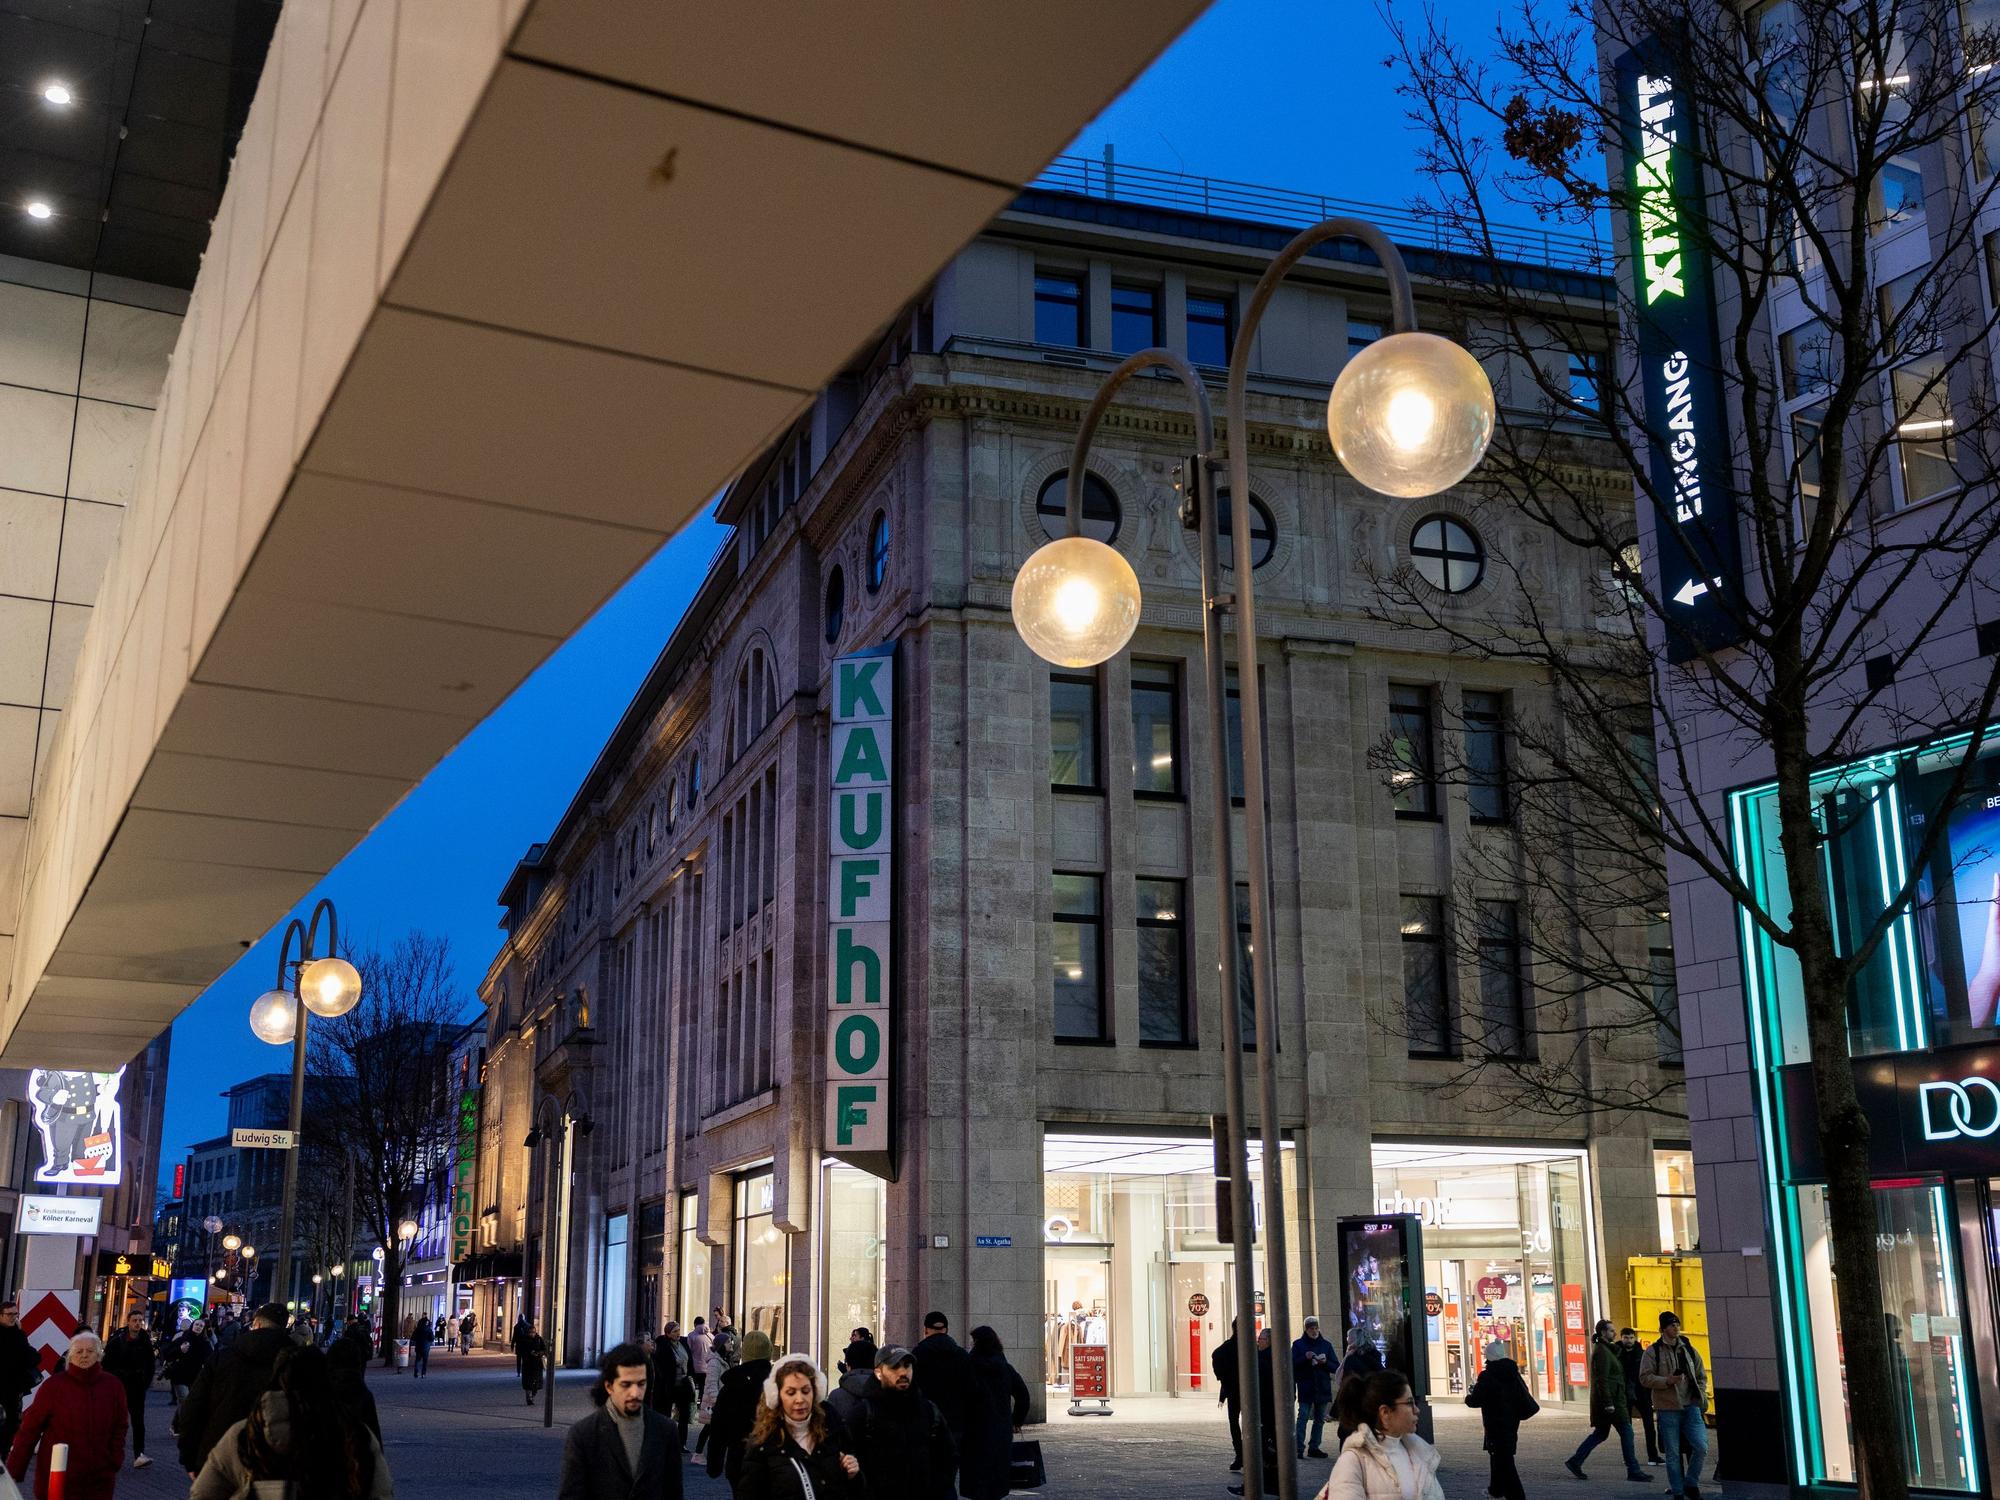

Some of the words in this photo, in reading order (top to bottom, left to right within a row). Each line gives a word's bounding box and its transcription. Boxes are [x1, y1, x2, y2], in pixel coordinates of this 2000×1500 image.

[1662, 349, 1703, 524] EINGANG
[235, 1132, 270, 1146] Ludwig
[272, 1134, 288, 1144] Str.
[42, 1214, 63, 1222] Kölner
[65, 1215, 94, 1223] Karneval
[993, 1238, 1011, 1246] Agatha
[1483, 1287, 1502, 1295] ZEIGE
[1190, 1304, 1209, 1312] 70%
[1564, 1300, 1582, 1310] SALE
[1567, 1344, 1585, 1354] SALE
